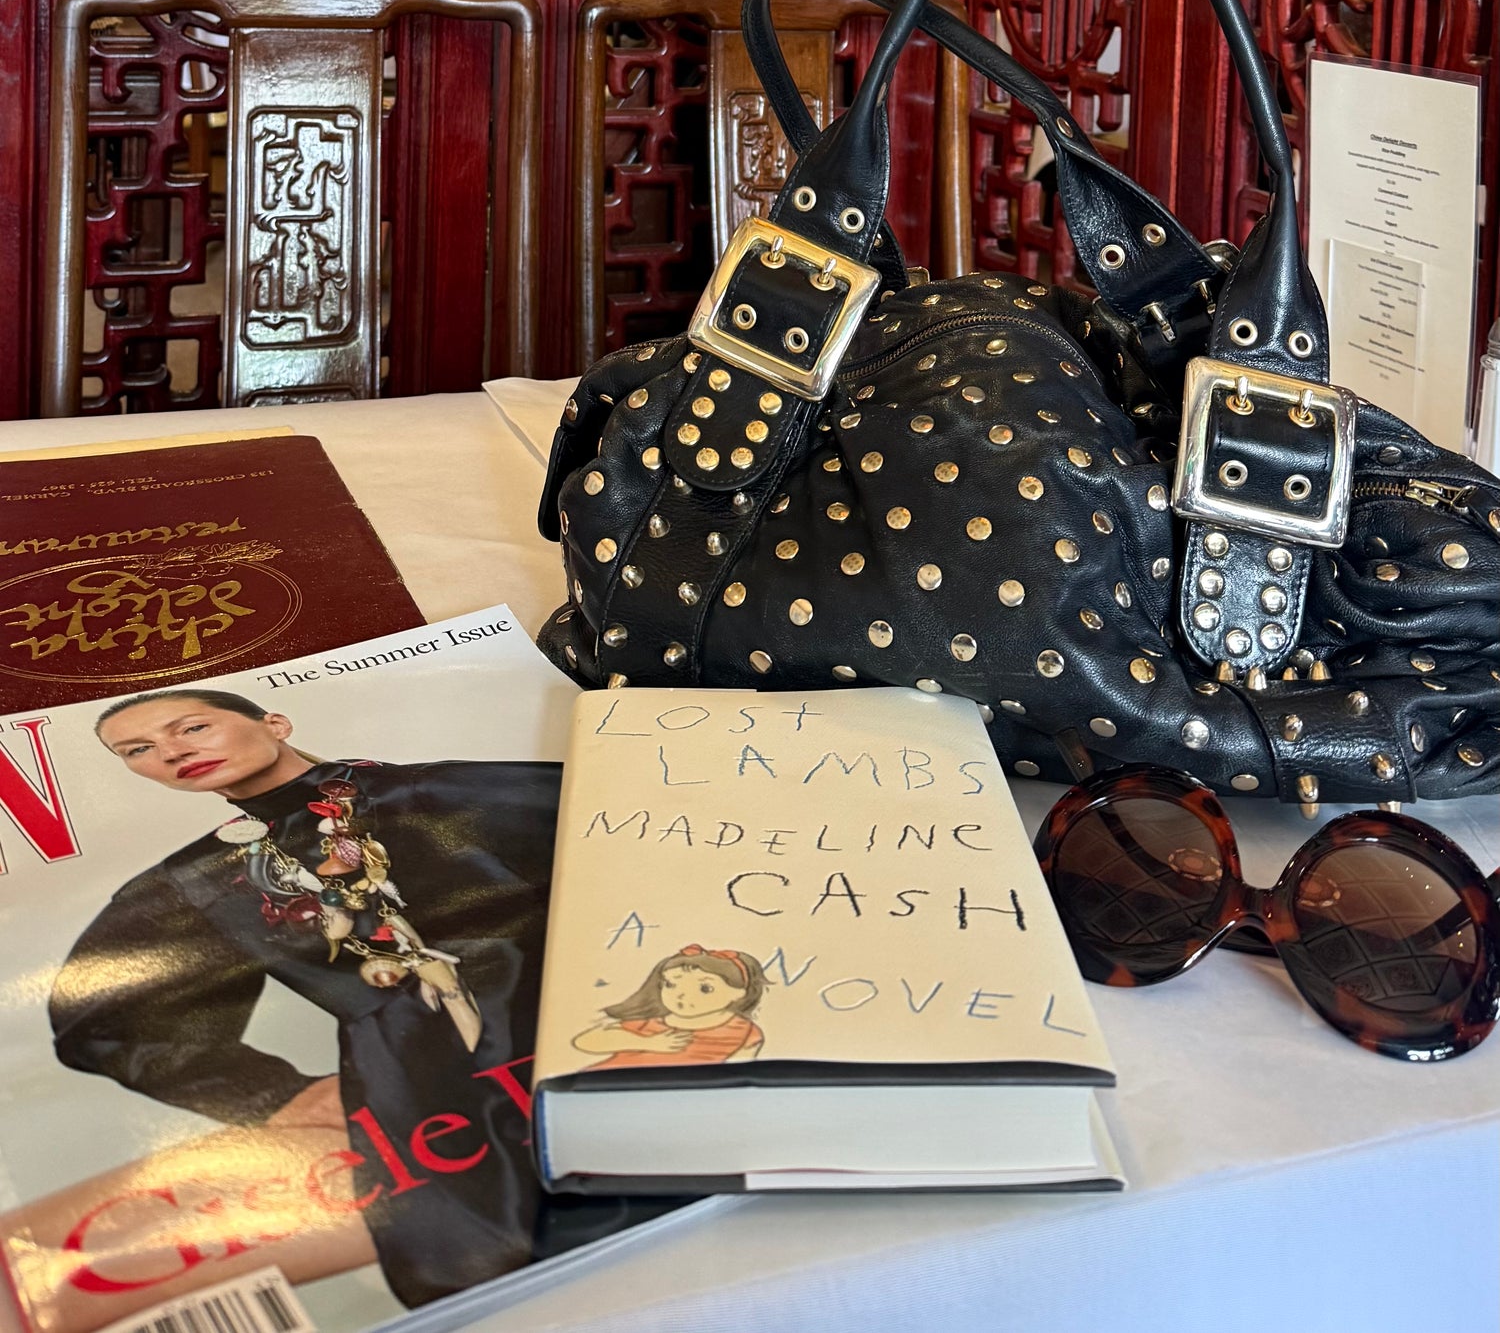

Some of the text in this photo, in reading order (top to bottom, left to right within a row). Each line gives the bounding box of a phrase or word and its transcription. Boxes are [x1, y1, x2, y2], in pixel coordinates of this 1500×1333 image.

[1, 491, 71, 502] CARMEL
[141, 473, 246, 491] CROSSROADS
[257, 619, 512, 690] The Summer Issue
[658, 744, 987, 795] LAMBS
[726, 871, 1028, 931] CASH
[607, 911, 1087, 1037] A NOVEL
